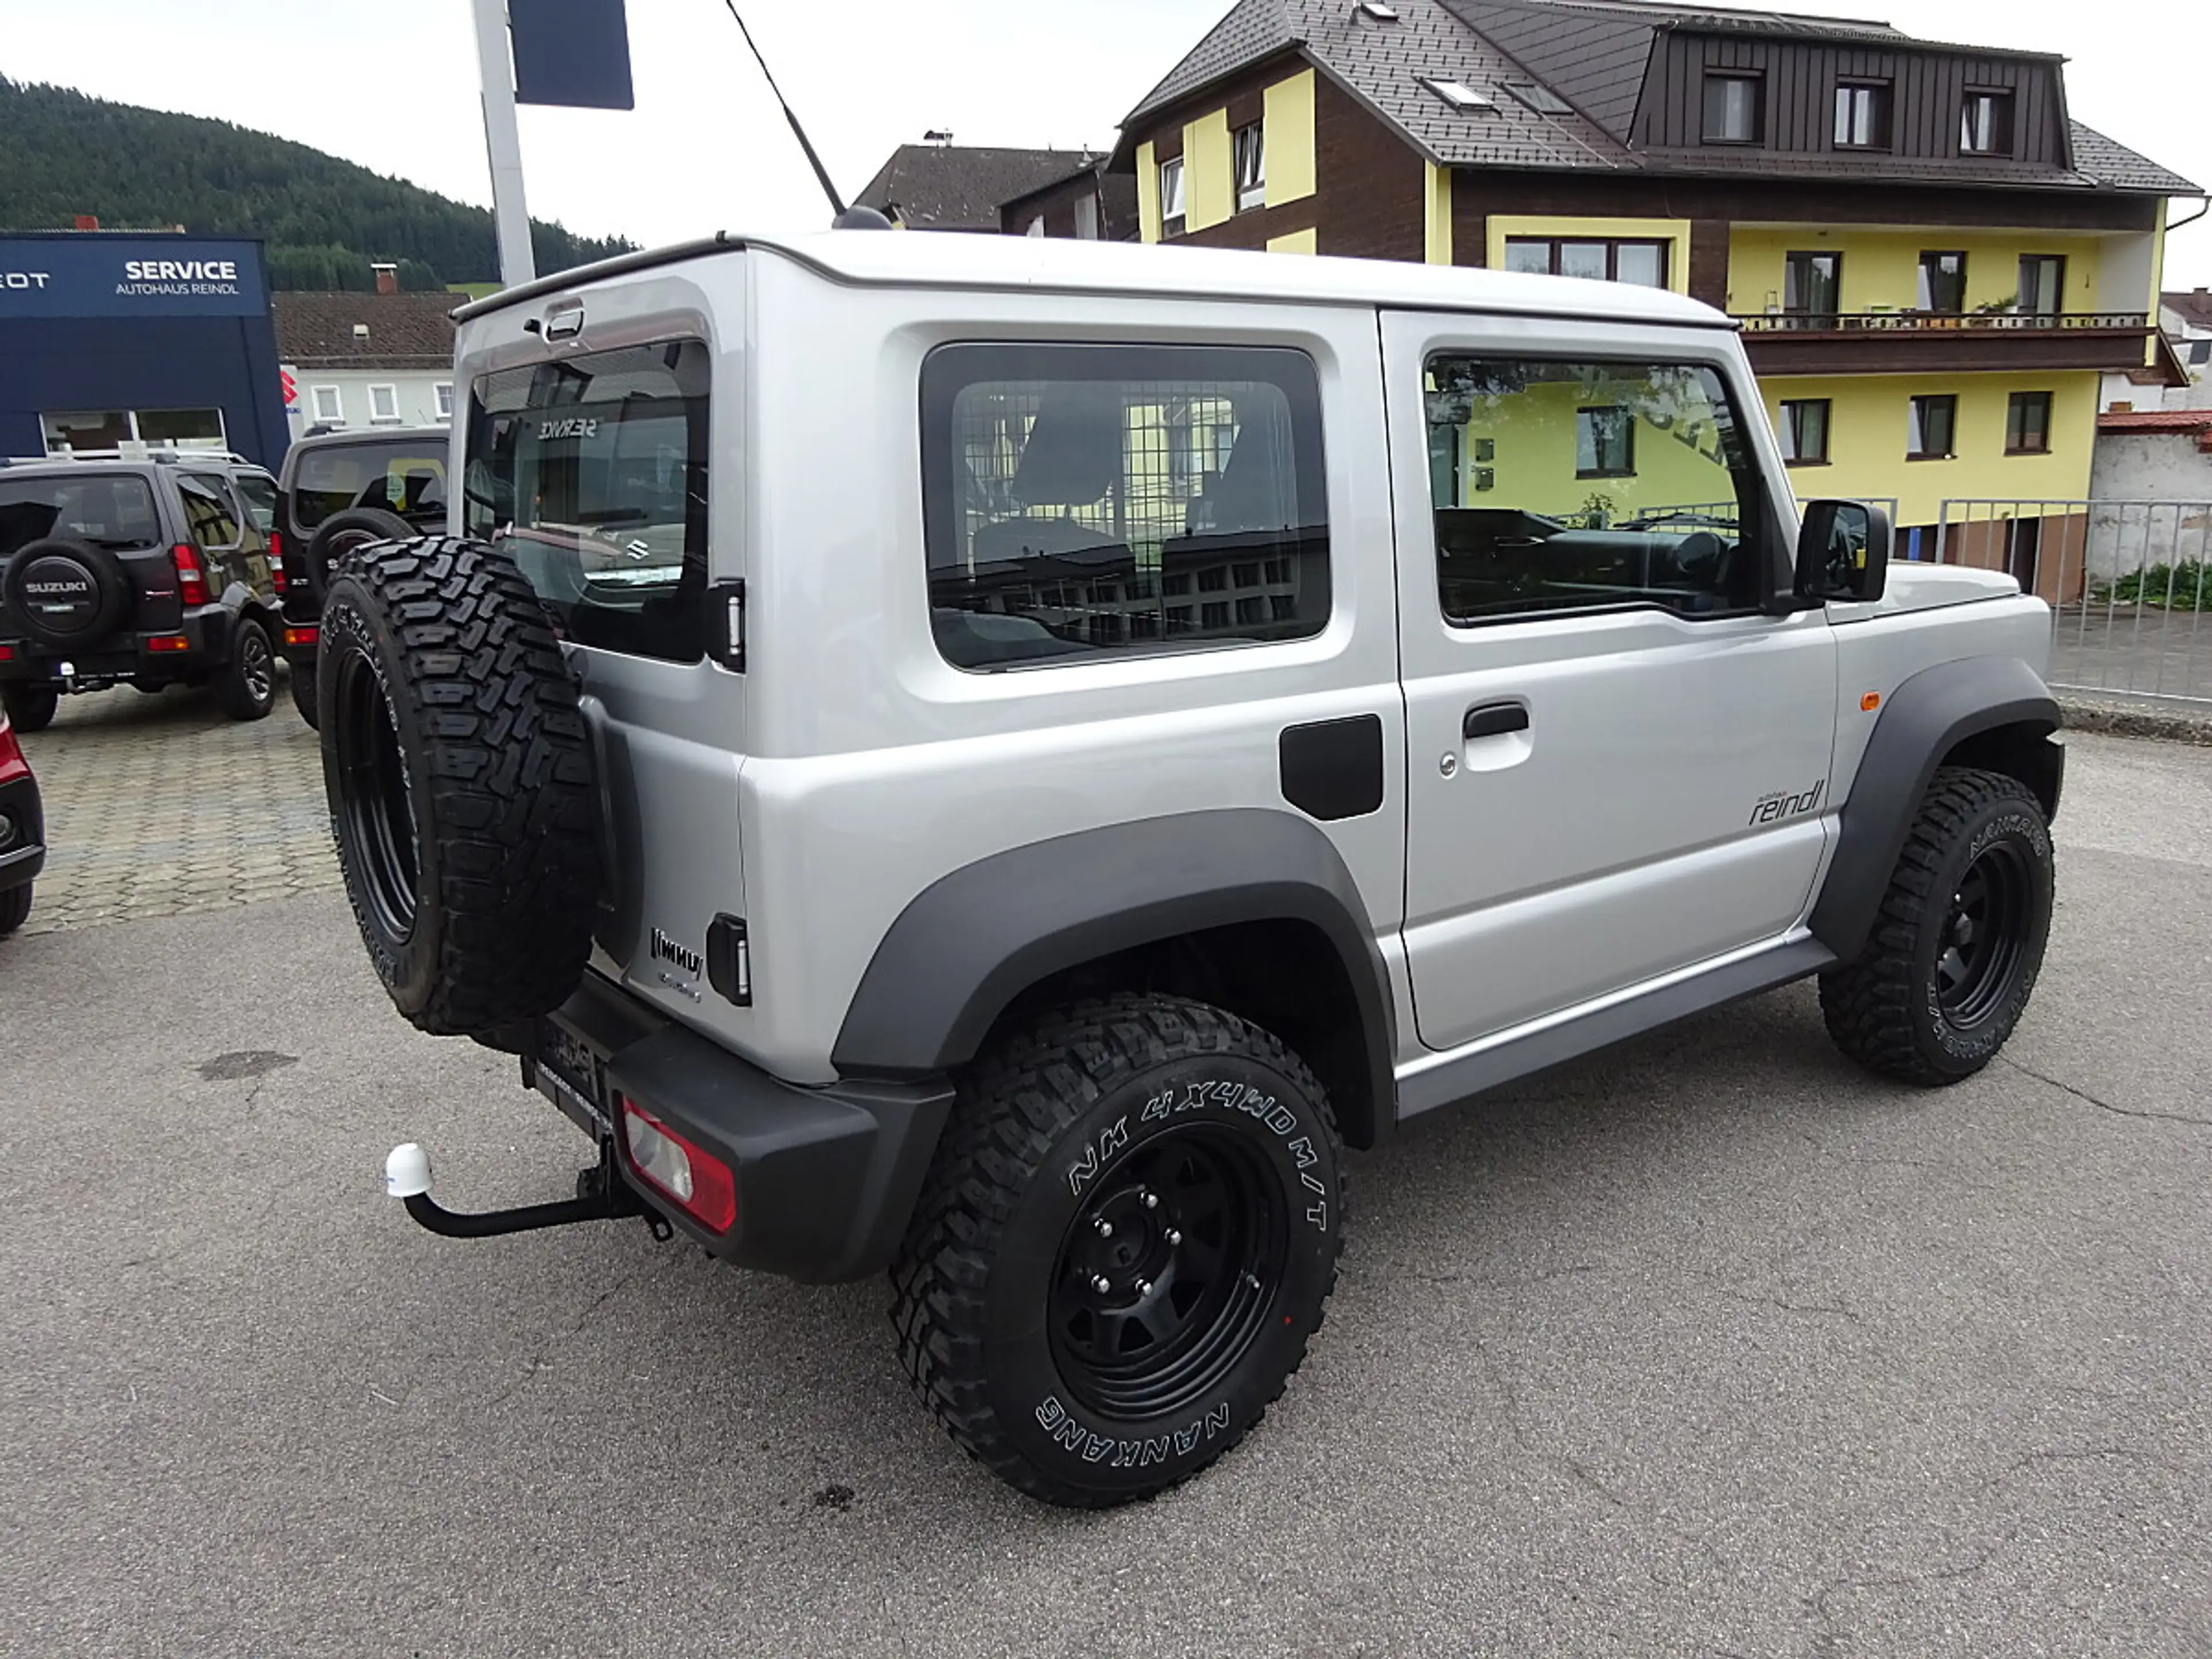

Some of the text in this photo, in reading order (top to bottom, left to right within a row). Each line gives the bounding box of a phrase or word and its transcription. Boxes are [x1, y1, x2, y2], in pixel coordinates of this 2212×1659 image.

[125, 260, 237, 280] SERVICE
[0, 272, 51, 289] OT
[116, 283, 240, 295] AUTOHAUS REINDL
[25, 581, 87, 593] SUZUKI
[1748, 779, 1824, 825] reindl
[1068, 1115, 1128, 1196] NK
[1287, 1136, 1327, 1232] M/T
[1035, 1396, 1230, 1467] NANKANG
